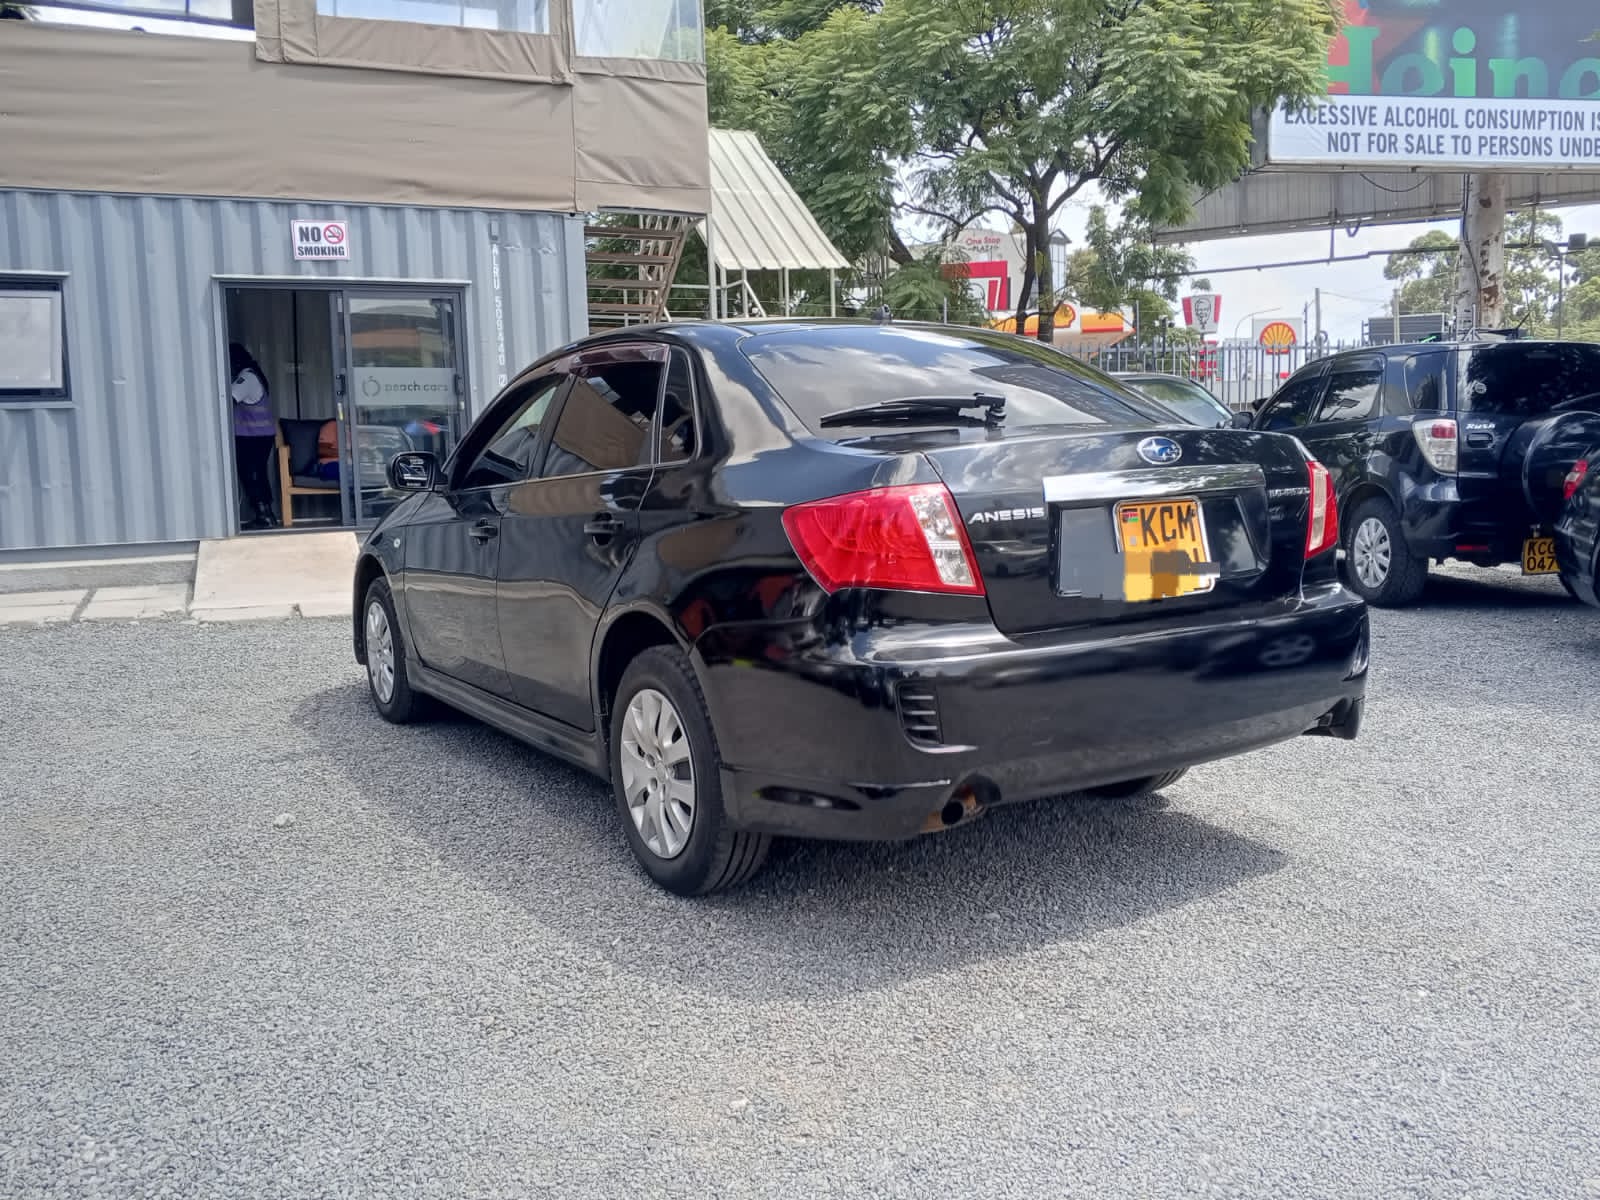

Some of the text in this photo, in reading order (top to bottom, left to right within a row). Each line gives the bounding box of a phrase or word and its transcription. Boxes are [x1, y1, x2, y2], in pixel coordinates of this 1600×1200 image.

[1284, 102, 1377, 126] EXCESSIVE
[1383, 106, 1459, 129] ALCOHOL
[1464, 108, 1585, 131] CONSUMPTION
[1327, 131, 1361, 153] NOT
[1367, 132, 1399, 154] FOR
[1404, 133, 1445, 155] SALE
[1451, 135, 1472, 155] TO
[1478, 135, 1553, 157] PERSONS
[298, 226, 322, 242] NO
[966, 237, 982, 246] One
[297, 245, 345, 257] SMOKING
[423, 383, 449, 392] cars
[968, 507, 1045, 525] ANESIS
[1140, 504, 1196, 547] KCM
[1526, 556, 1556, 572] 047
